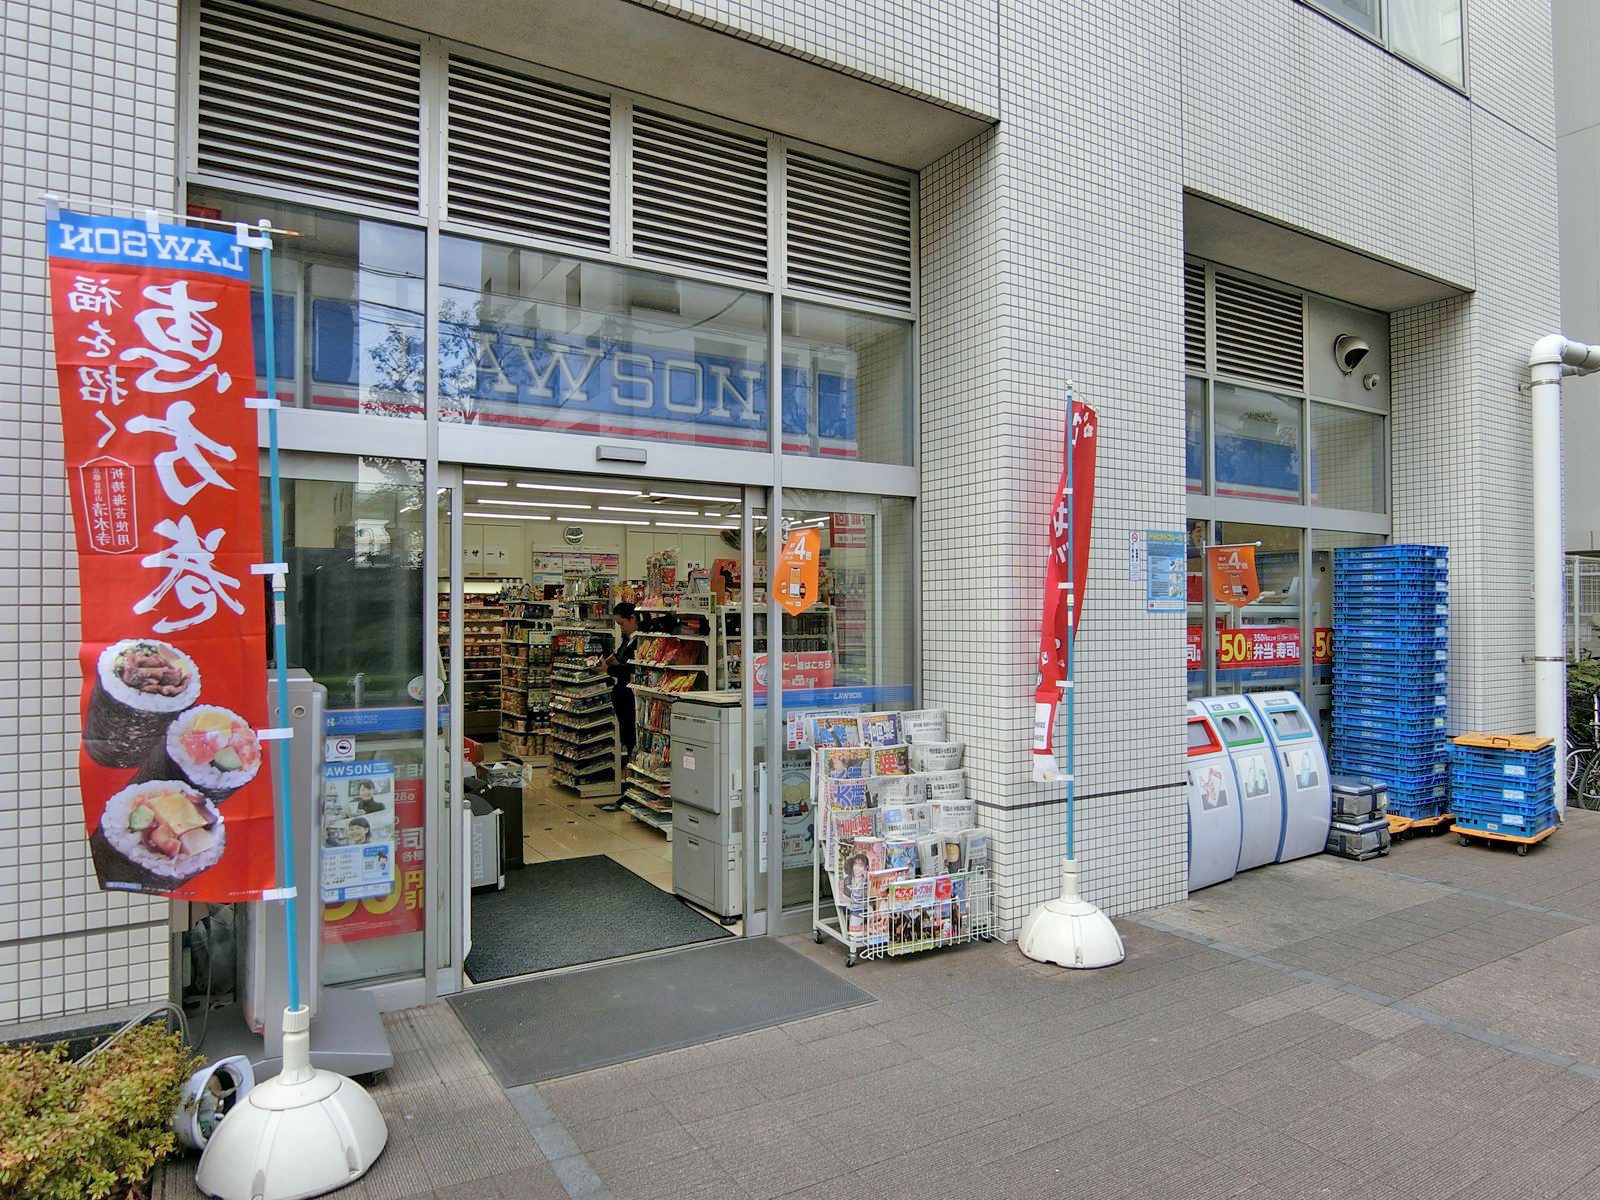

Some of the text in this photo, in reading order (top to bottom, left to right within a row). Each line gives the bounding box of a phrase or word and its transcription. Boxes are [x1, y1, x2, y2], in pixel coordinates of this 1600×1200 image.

[471, 332, 762, 422] AWSON
[1221, 633, 1247, 662] 50
[326, 763, 372, 777] AWSON
[472, 822, 484, 880] LAWSON
